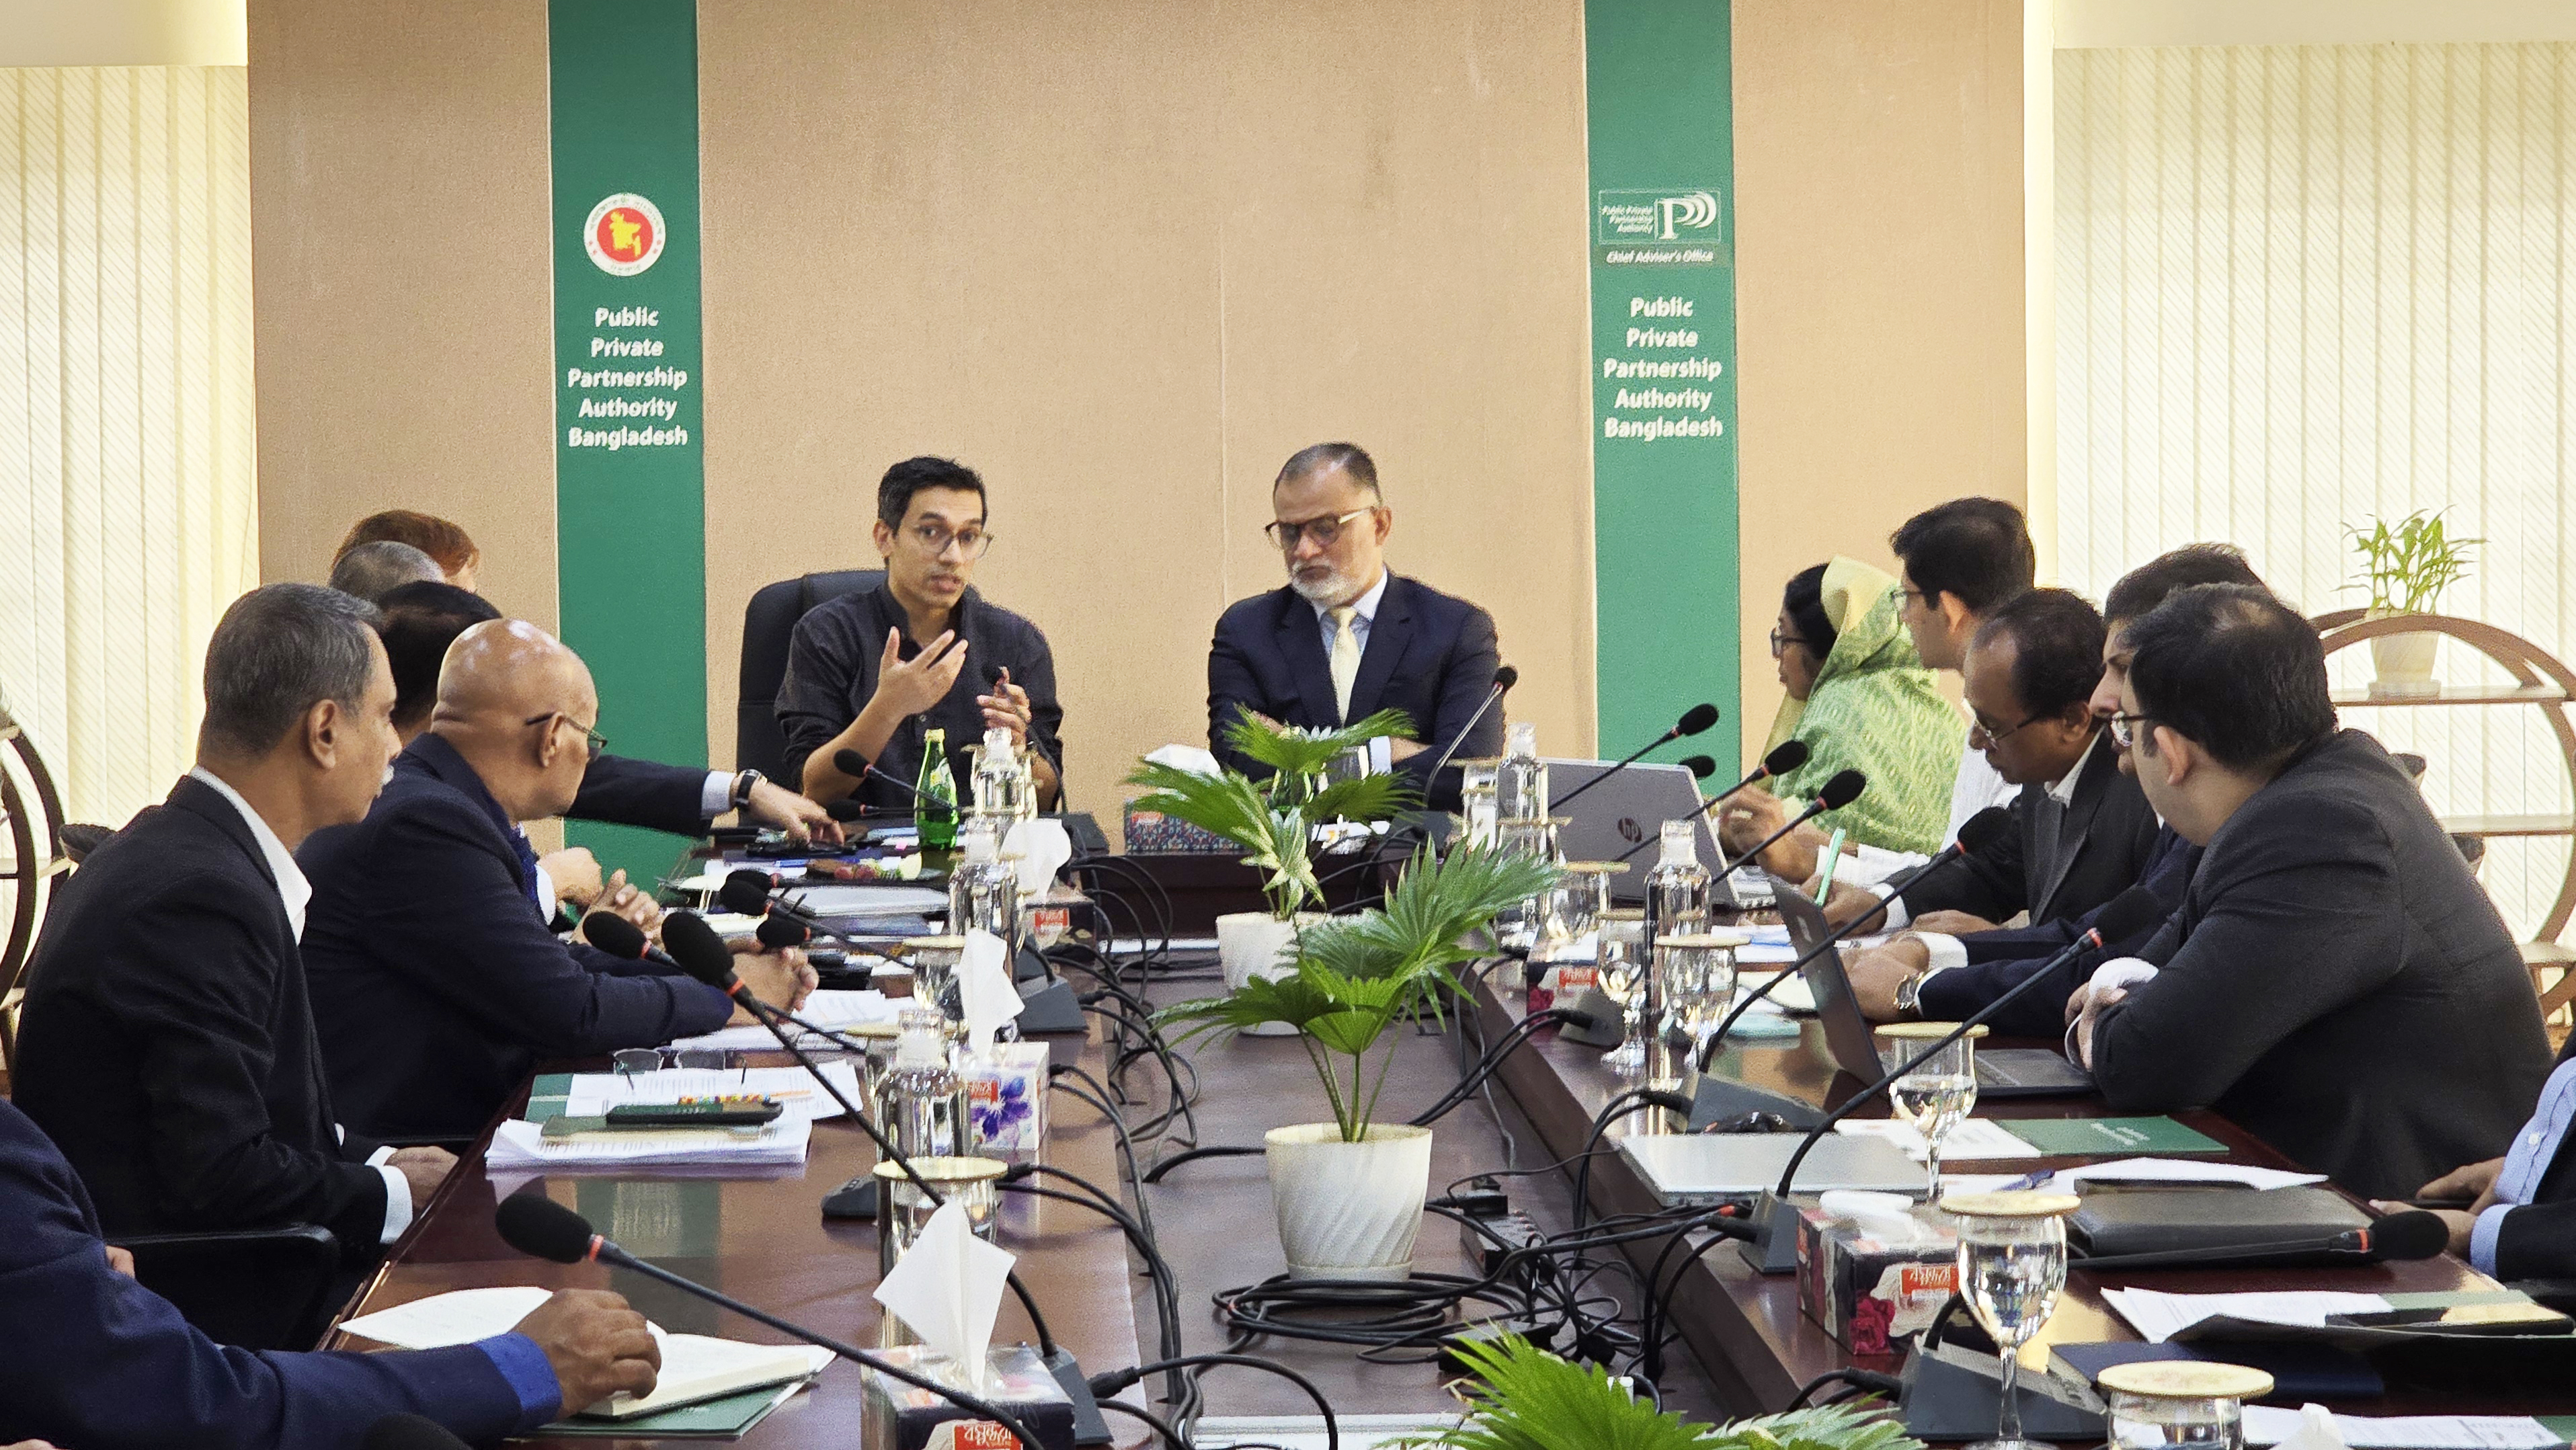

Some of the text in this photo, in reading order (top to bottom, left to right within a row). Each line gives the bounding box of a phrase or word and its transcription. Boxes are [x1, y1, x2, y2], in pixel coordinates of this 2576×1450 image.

[595, 306, 659, 327] Public
[1630, 296, 1693, 319] Public
[591, 337, 663, 358] Private
[1626, 327, 1699, 349] Private
[568, 366, 687, 391] Partnership
[1603, 357, 1722, 382] Partnership
[579, 397, 677, 421] Authority
[1614, 387, 1712, 413] Authority
[568, 425, 688, 450] Bangladesh
[1604, 415, 1724, 442] Bangladesh
